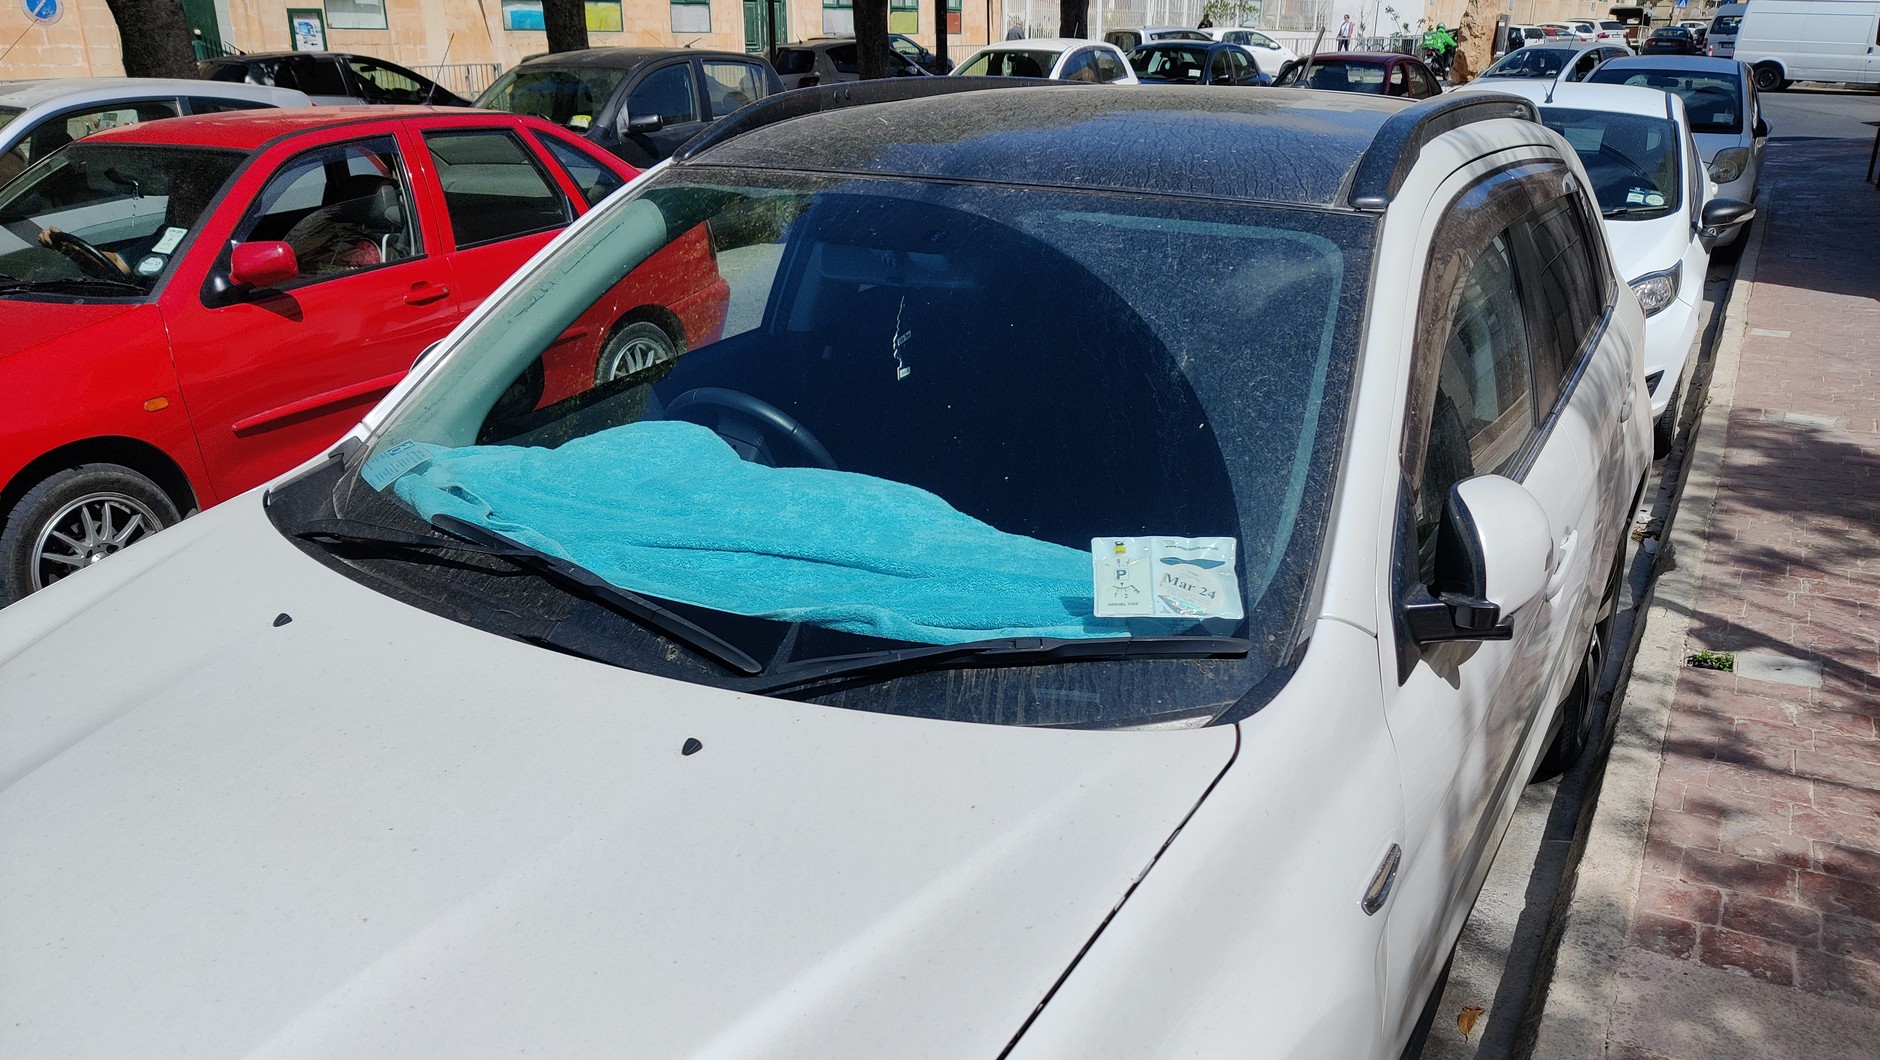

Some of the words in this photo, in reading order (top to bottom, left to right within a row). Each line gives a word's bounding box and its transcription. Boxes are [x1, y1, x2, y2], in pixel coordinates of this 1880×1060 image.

[1116, 570, 1126, 580] P
[1164, 573, 1196, 591] Mar
[1199, 587, 1216, 600] 24
